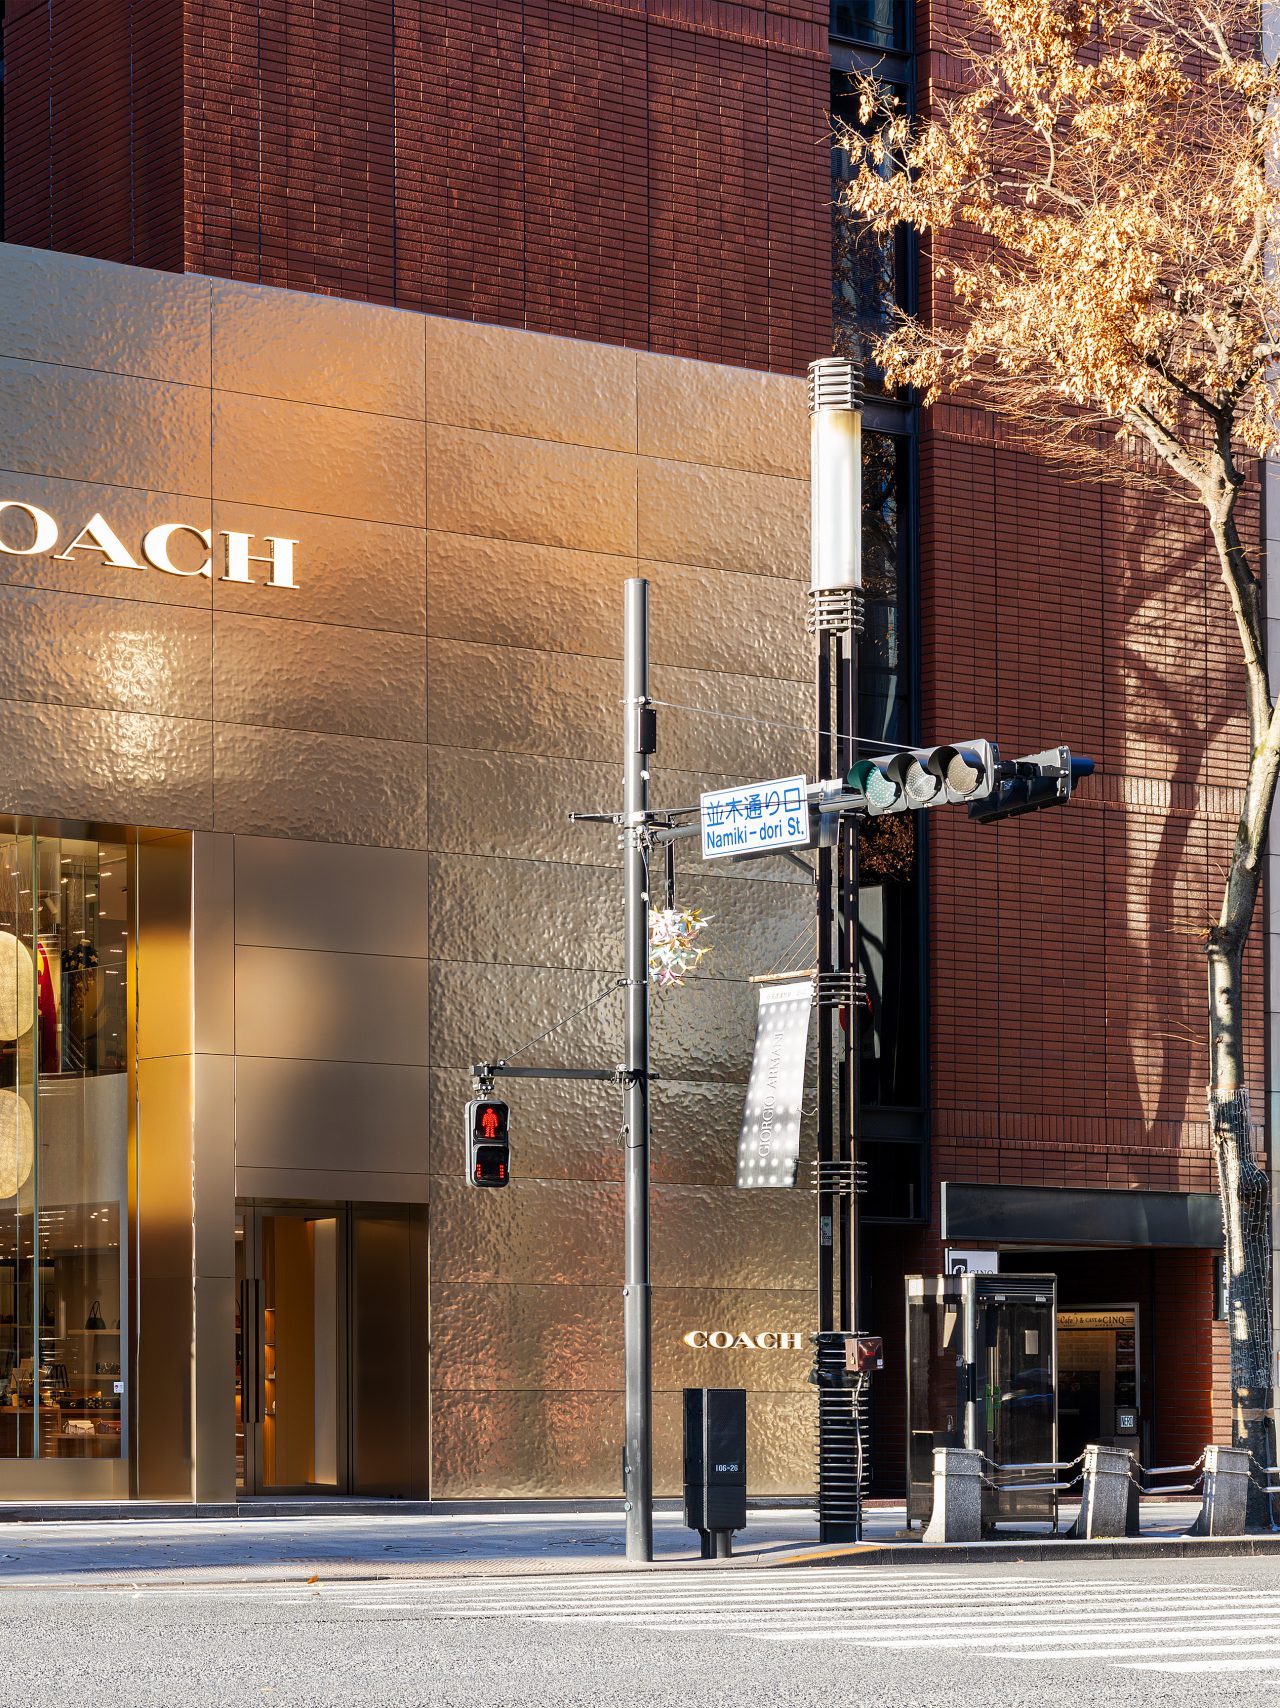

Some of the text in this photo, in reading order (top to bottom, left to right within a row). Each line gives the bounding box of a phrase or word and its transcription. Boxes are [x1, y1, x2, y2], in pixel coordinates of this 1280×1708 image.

[706, 787, 801, 827] 並木通り口
[787, 816, 805, 837] St.
[758, 1032, 784, 1158] GIORGIO ARMANI
[1102, 1316, 1126, 1326] CINQ
[683, 1331, 804, 1350] COACH
